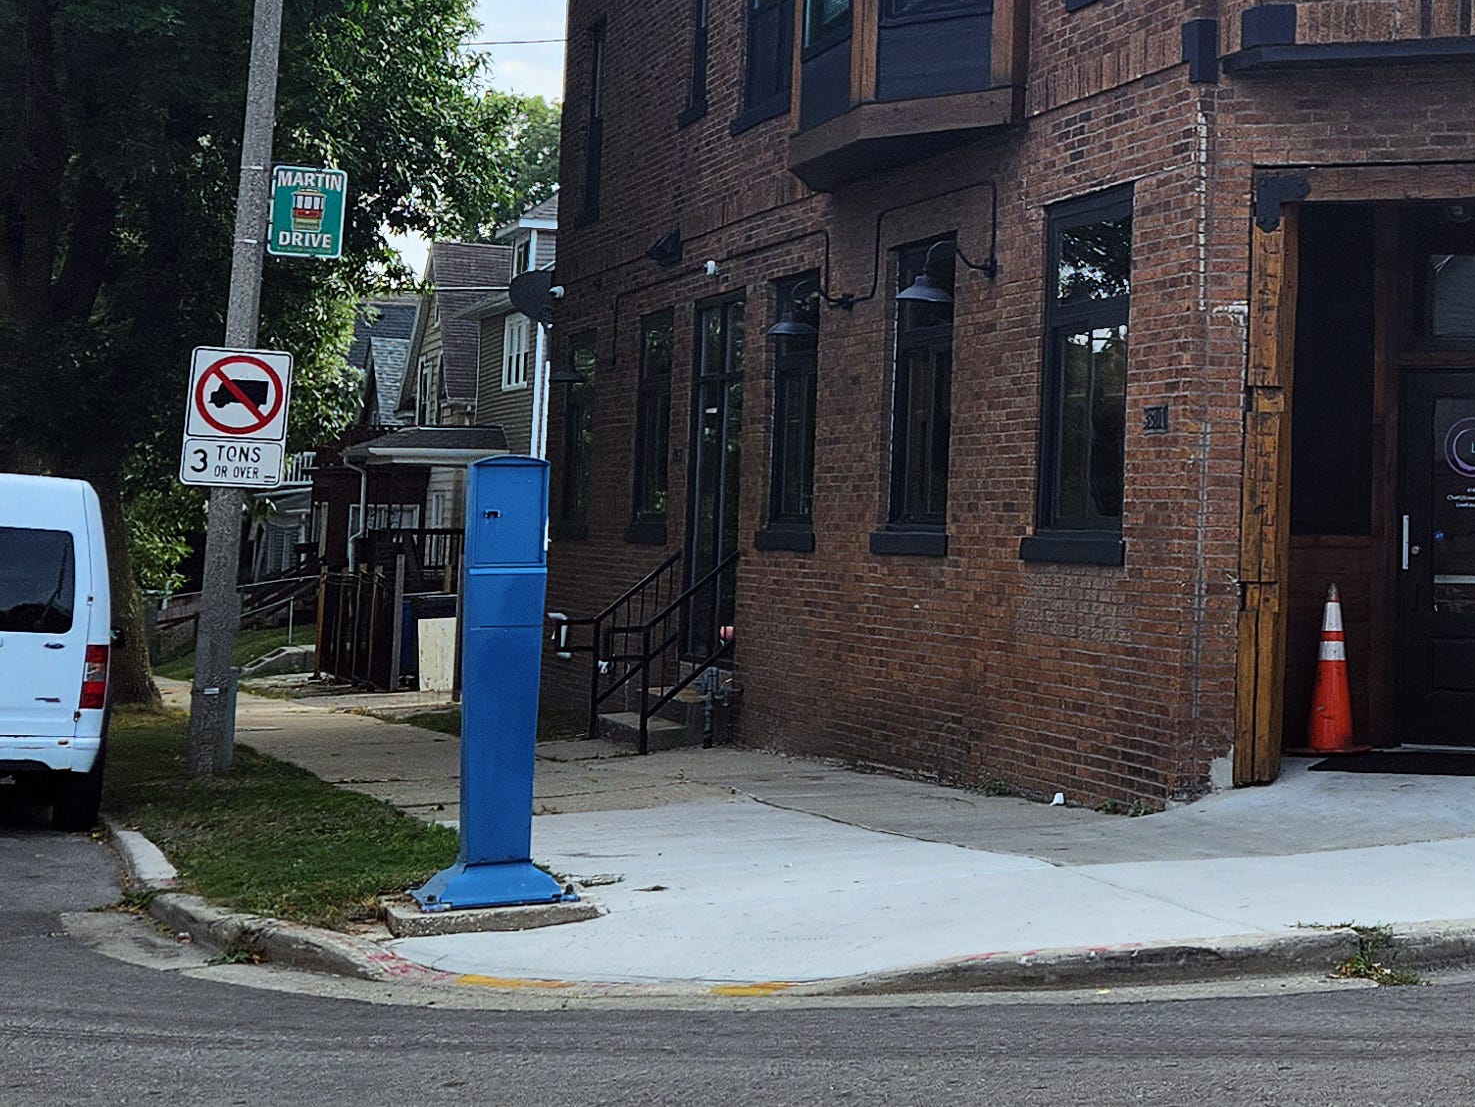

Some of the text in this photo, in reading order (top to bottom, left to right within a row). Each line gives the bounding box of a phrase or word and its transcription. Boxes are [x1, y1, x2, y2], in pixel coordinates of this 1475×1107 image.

[277, 170, 342, 192] MARTIN
[278, 230, 332, 248] DRIVE
[190, 445, 262, 473] 3 TONS
[214, 465, 259, 479] OR OVER
